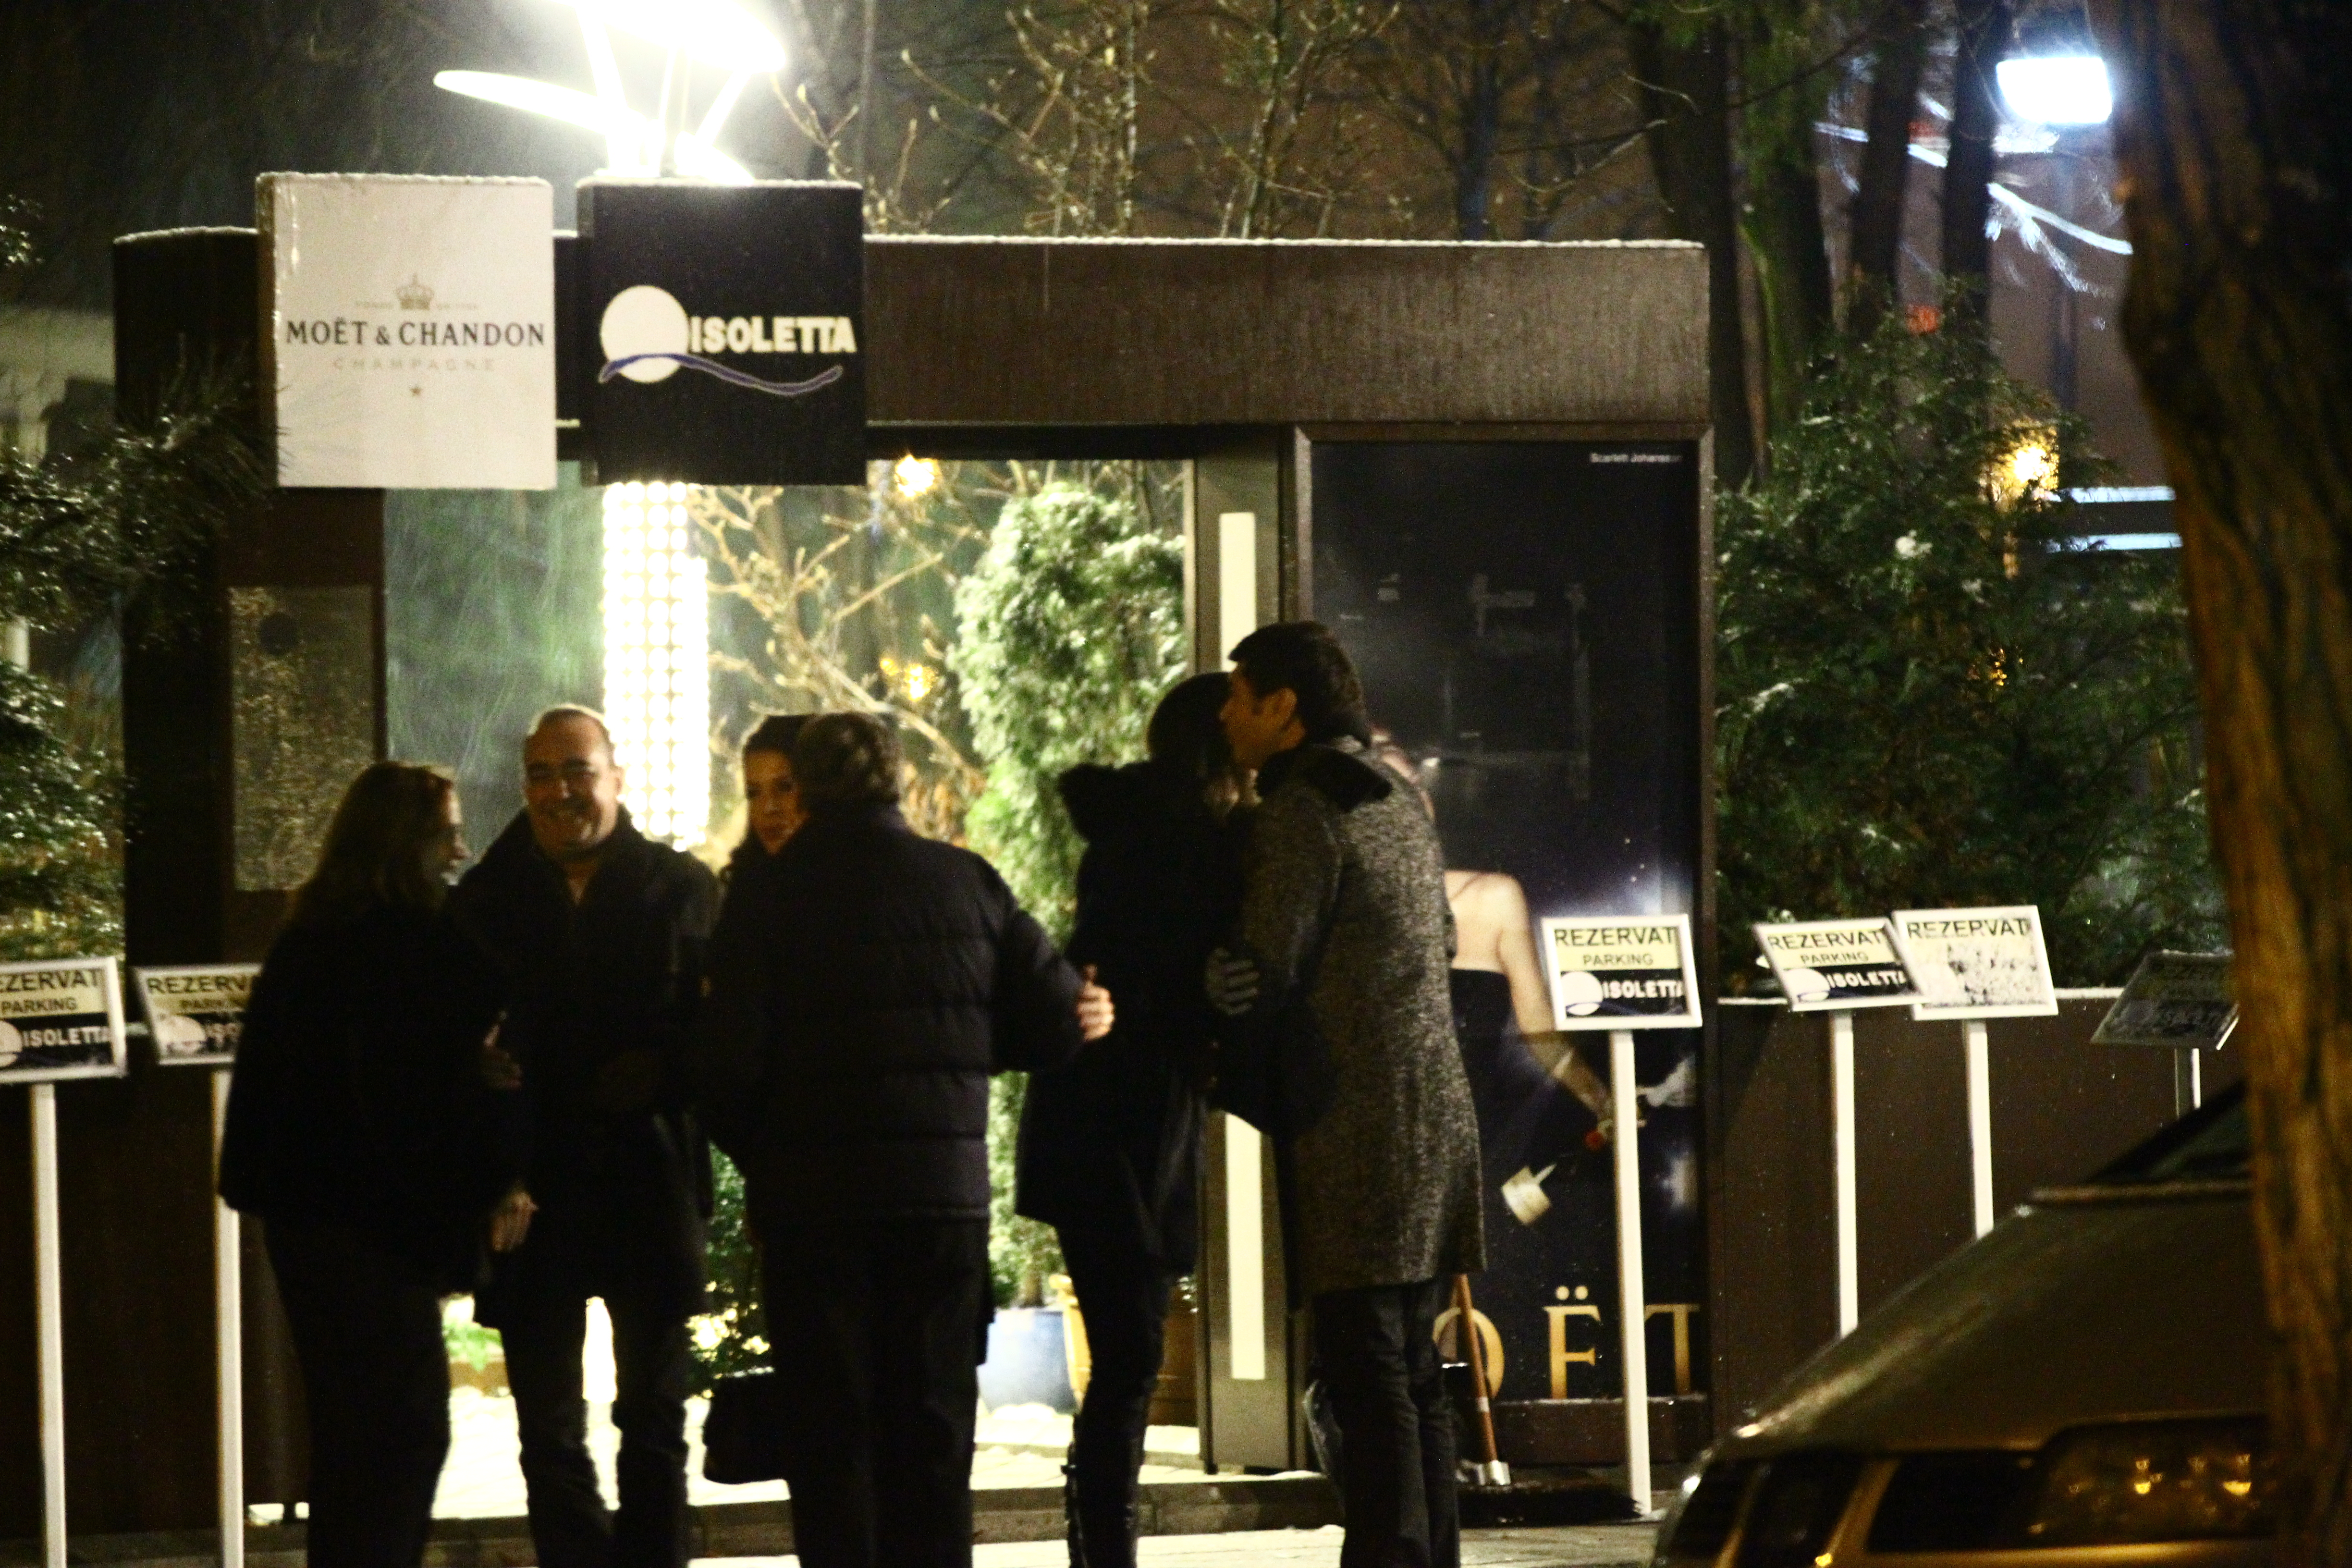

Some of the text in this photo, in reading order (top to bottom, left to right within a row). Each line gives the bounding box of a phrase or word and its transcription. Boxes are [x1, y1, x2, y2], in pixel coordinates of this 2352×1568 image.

[285, 316, 544, 347] MOËT & CHANDON
[690, 315, 858, 354] ISOLETTA
[333, 357, 494, 371] CHAMPAGNE
[1554, 927, 1676, 946] REZERVAT
[1768, 930, 1884, 950] REZERVAT
[1583, 953, 1654, 966] PARKING
[1801, 950, 1869, 965] PARKING
[0, 968, 100, 993] ZERVAT
[1, 996, 78, 1015] PARKING
